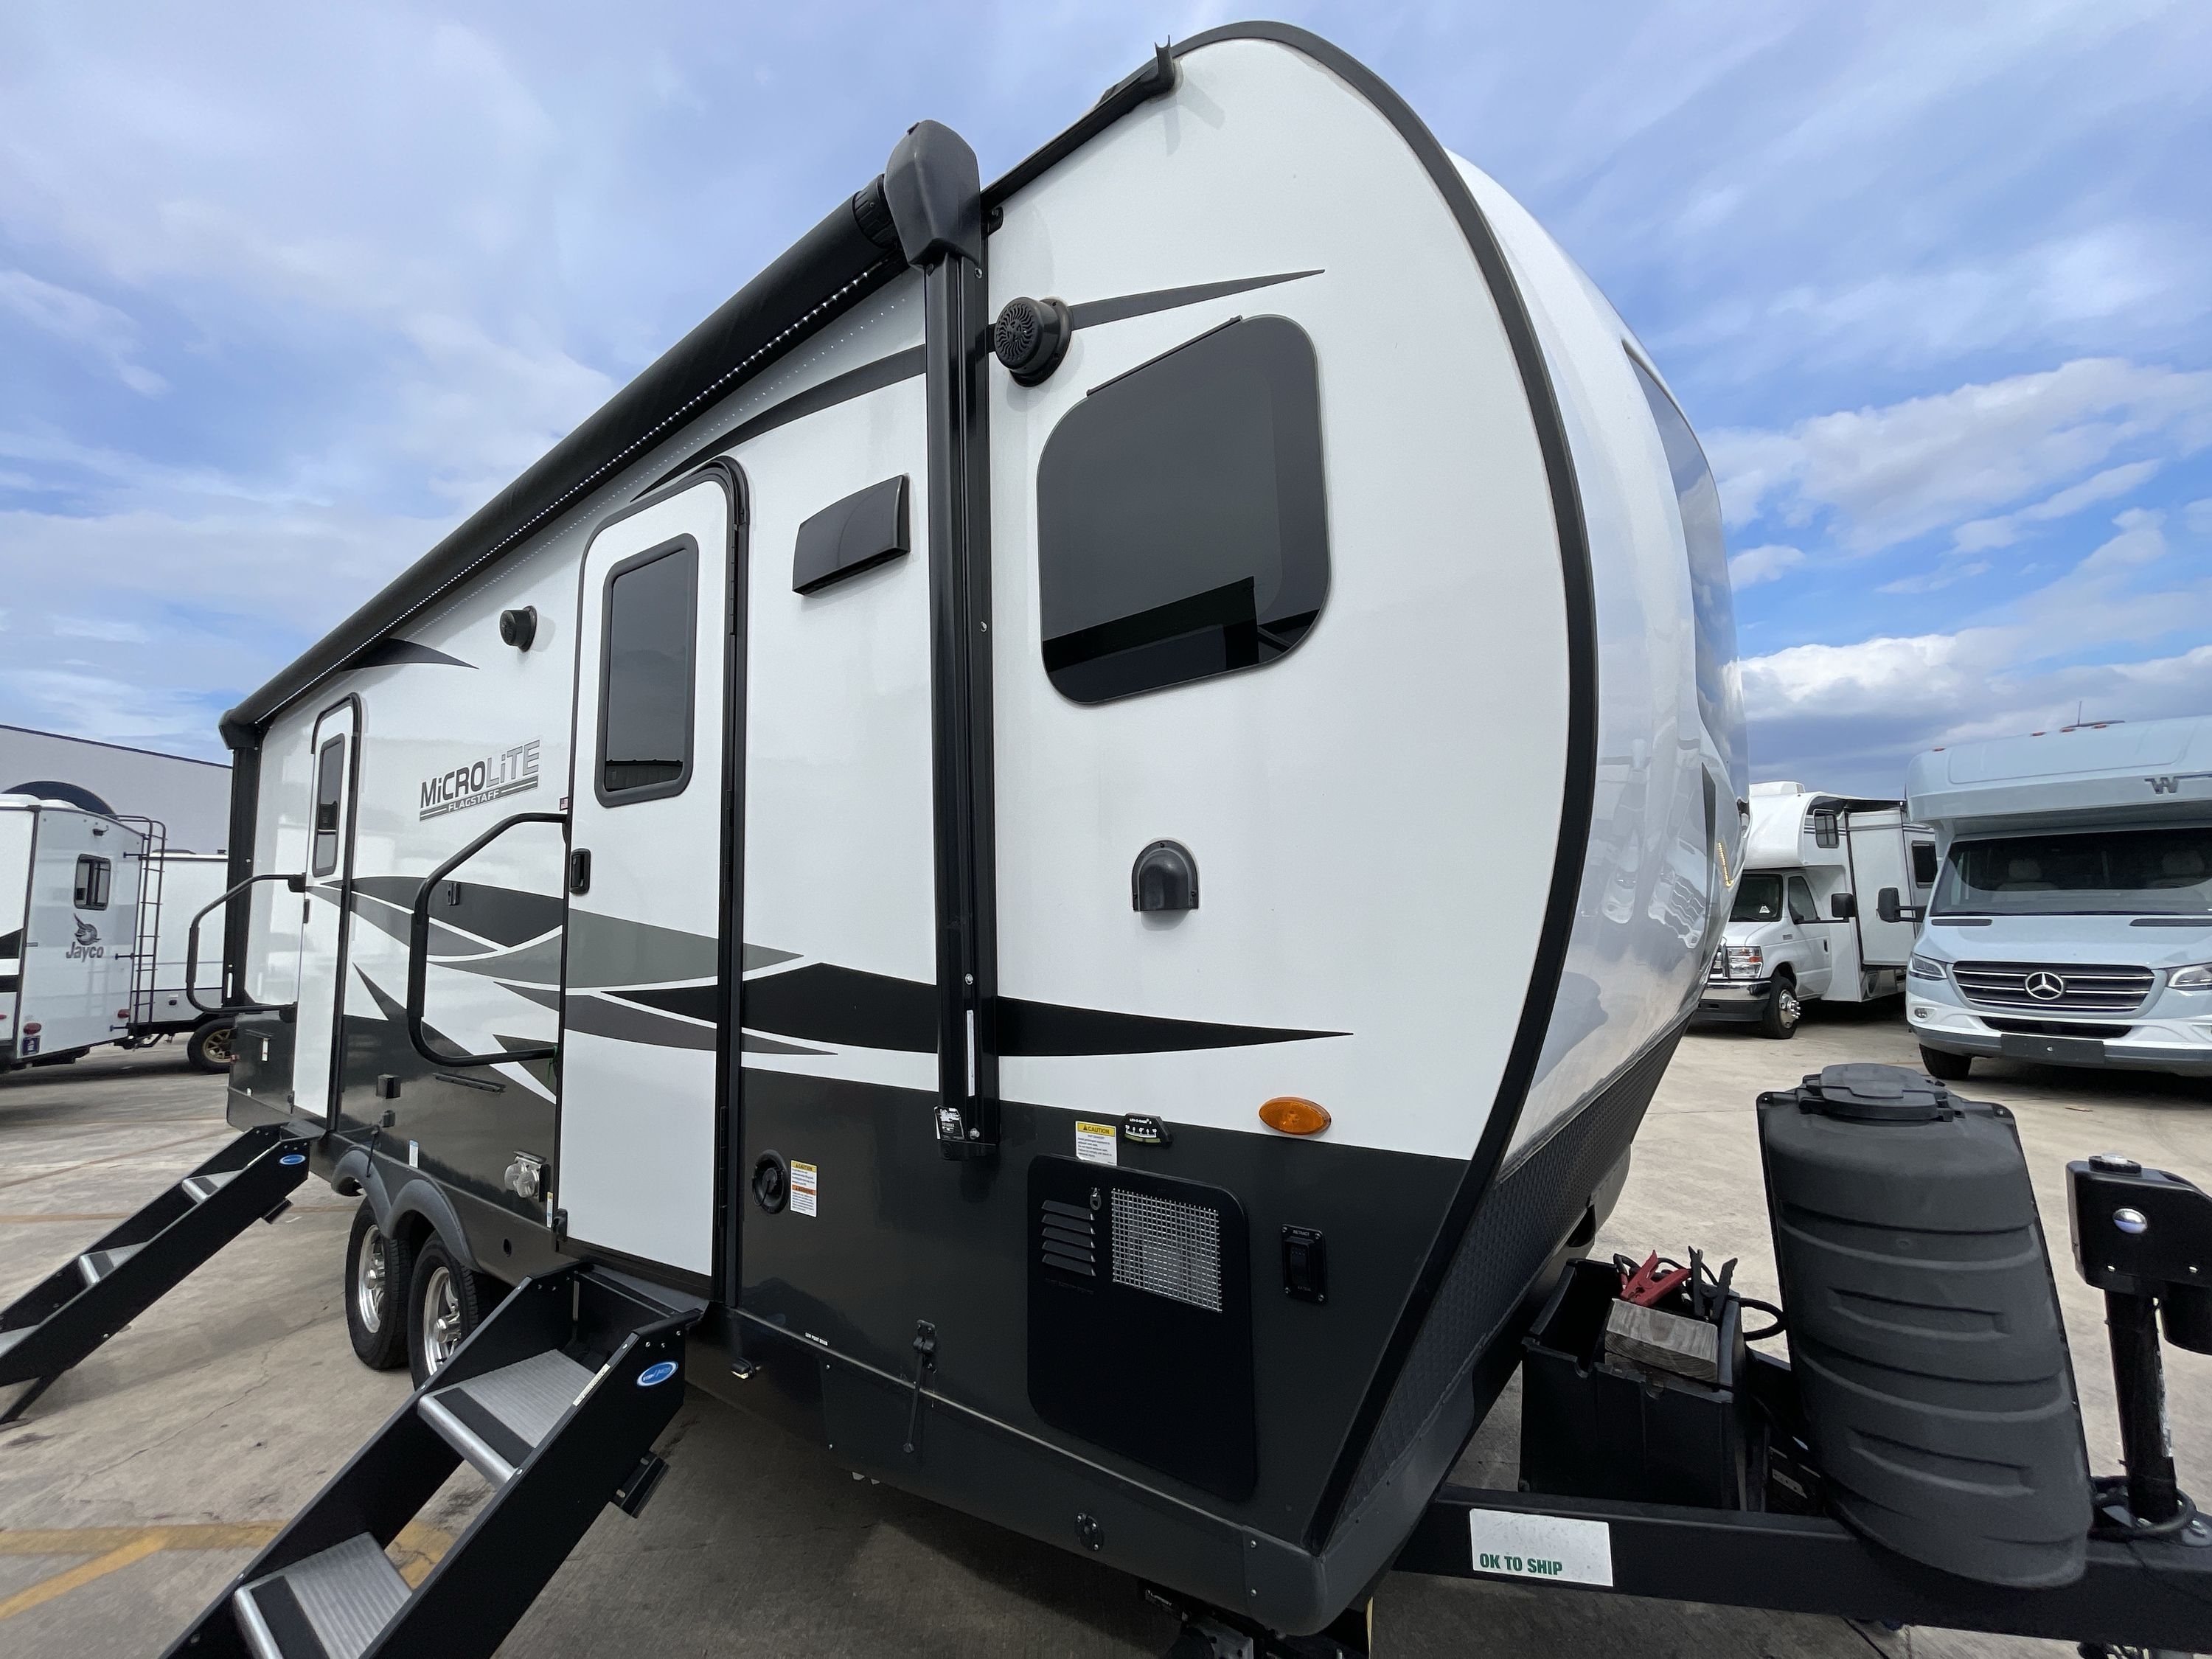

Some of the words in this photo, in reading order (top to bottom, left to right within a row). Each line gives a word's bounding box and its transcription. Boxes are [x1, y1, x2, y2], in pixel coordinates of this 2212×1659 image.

[448, 789, 499, 813] FLAGSTAFF
[66, 942, 104, 963] Jayco
[1088, 1126, 1110, 1135] CAUTION
[1479, 1553, 1500, 1570] OK
[1504, 1556, 1523, 1572] TO
[1527, 1558, 1562, 1576] SHIP
